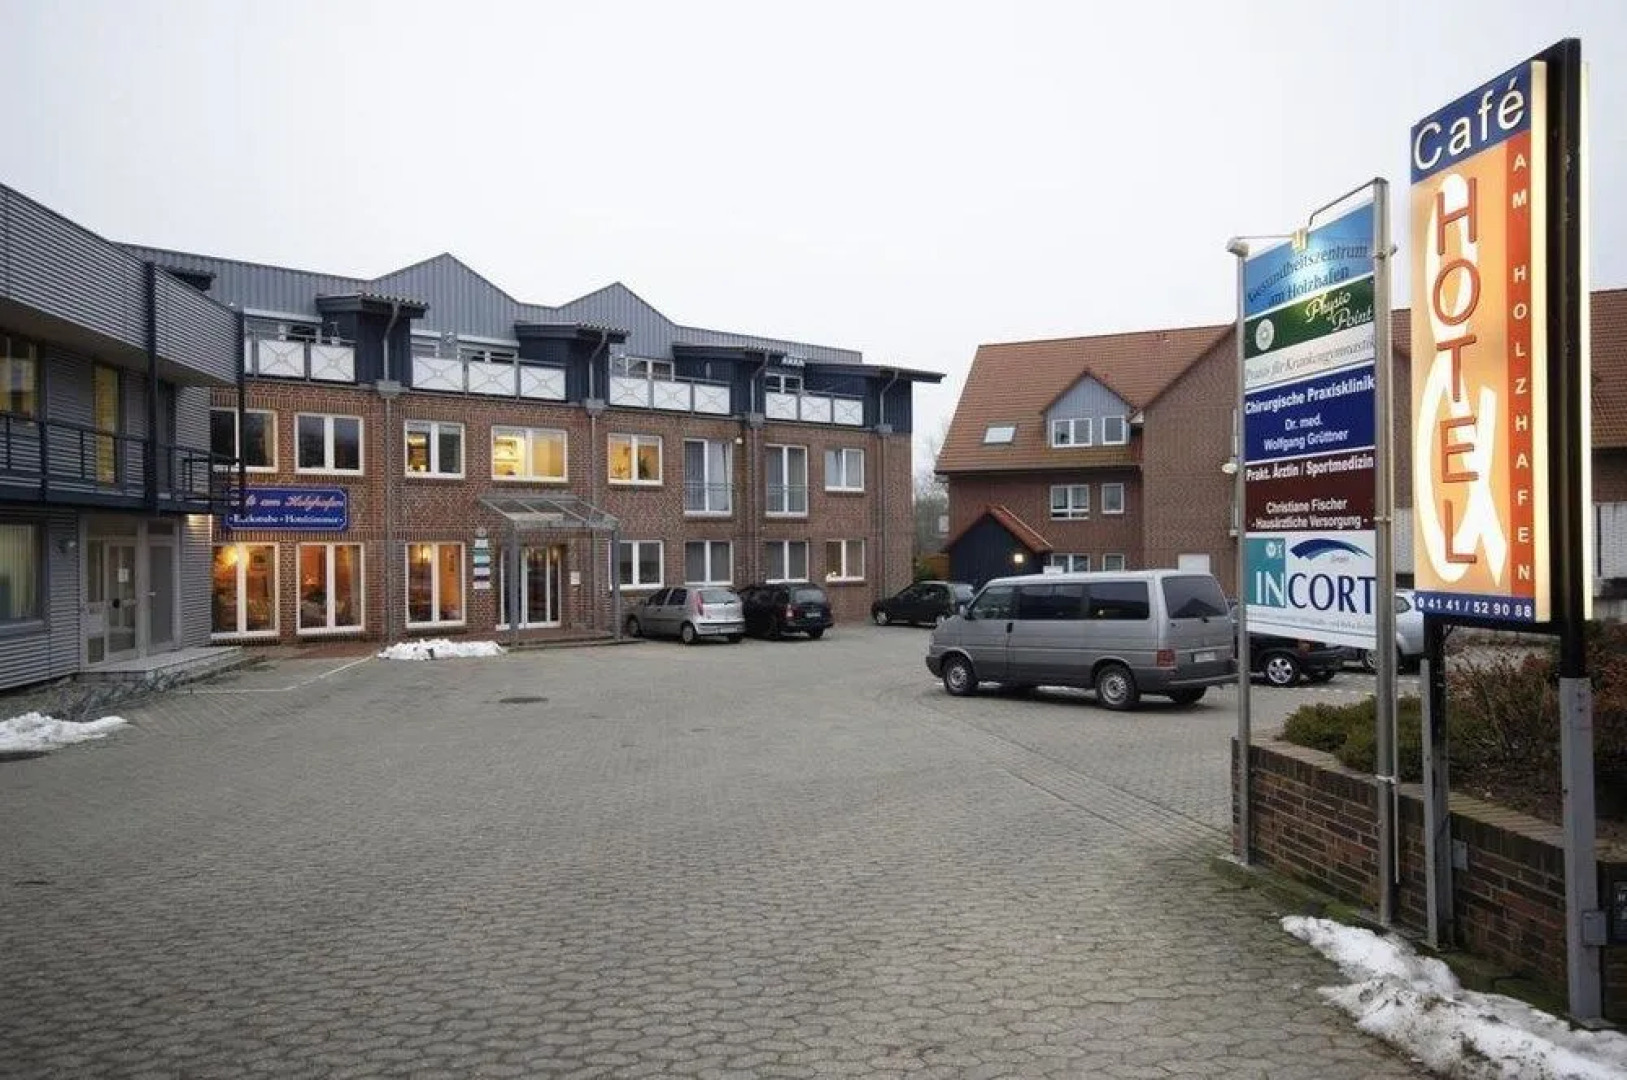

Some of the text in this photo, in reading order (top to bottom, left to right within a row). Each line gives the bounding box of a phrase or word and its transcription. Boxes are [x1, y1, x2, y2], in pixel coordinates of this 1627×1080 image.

[1413, 77, 1524, 171] Café
[1305, 290, 1351, 323] Physio
[1328, 305, 1374, 331] Point
[1433, 176, 1481, 563] HOTEL
[1513, 153, 1530, 581] AM HOLZHAFEN
[1245, 374, 1374, 414] Chirurgische Praxisklinik
[1285, 413, 1323, 431] Dr. med.
[1264, 435, 1305, 451] Wolfgang
[1246, 468, 1271, 481] Prakt.
[1306, 454, 1374, 477] Sportmedizin
[1266, 498, 1347, 514] Christiane Fischer
[1310, 515, 1361, 530] Versorgung
[1256, 570, 1376, 614] INCORT
